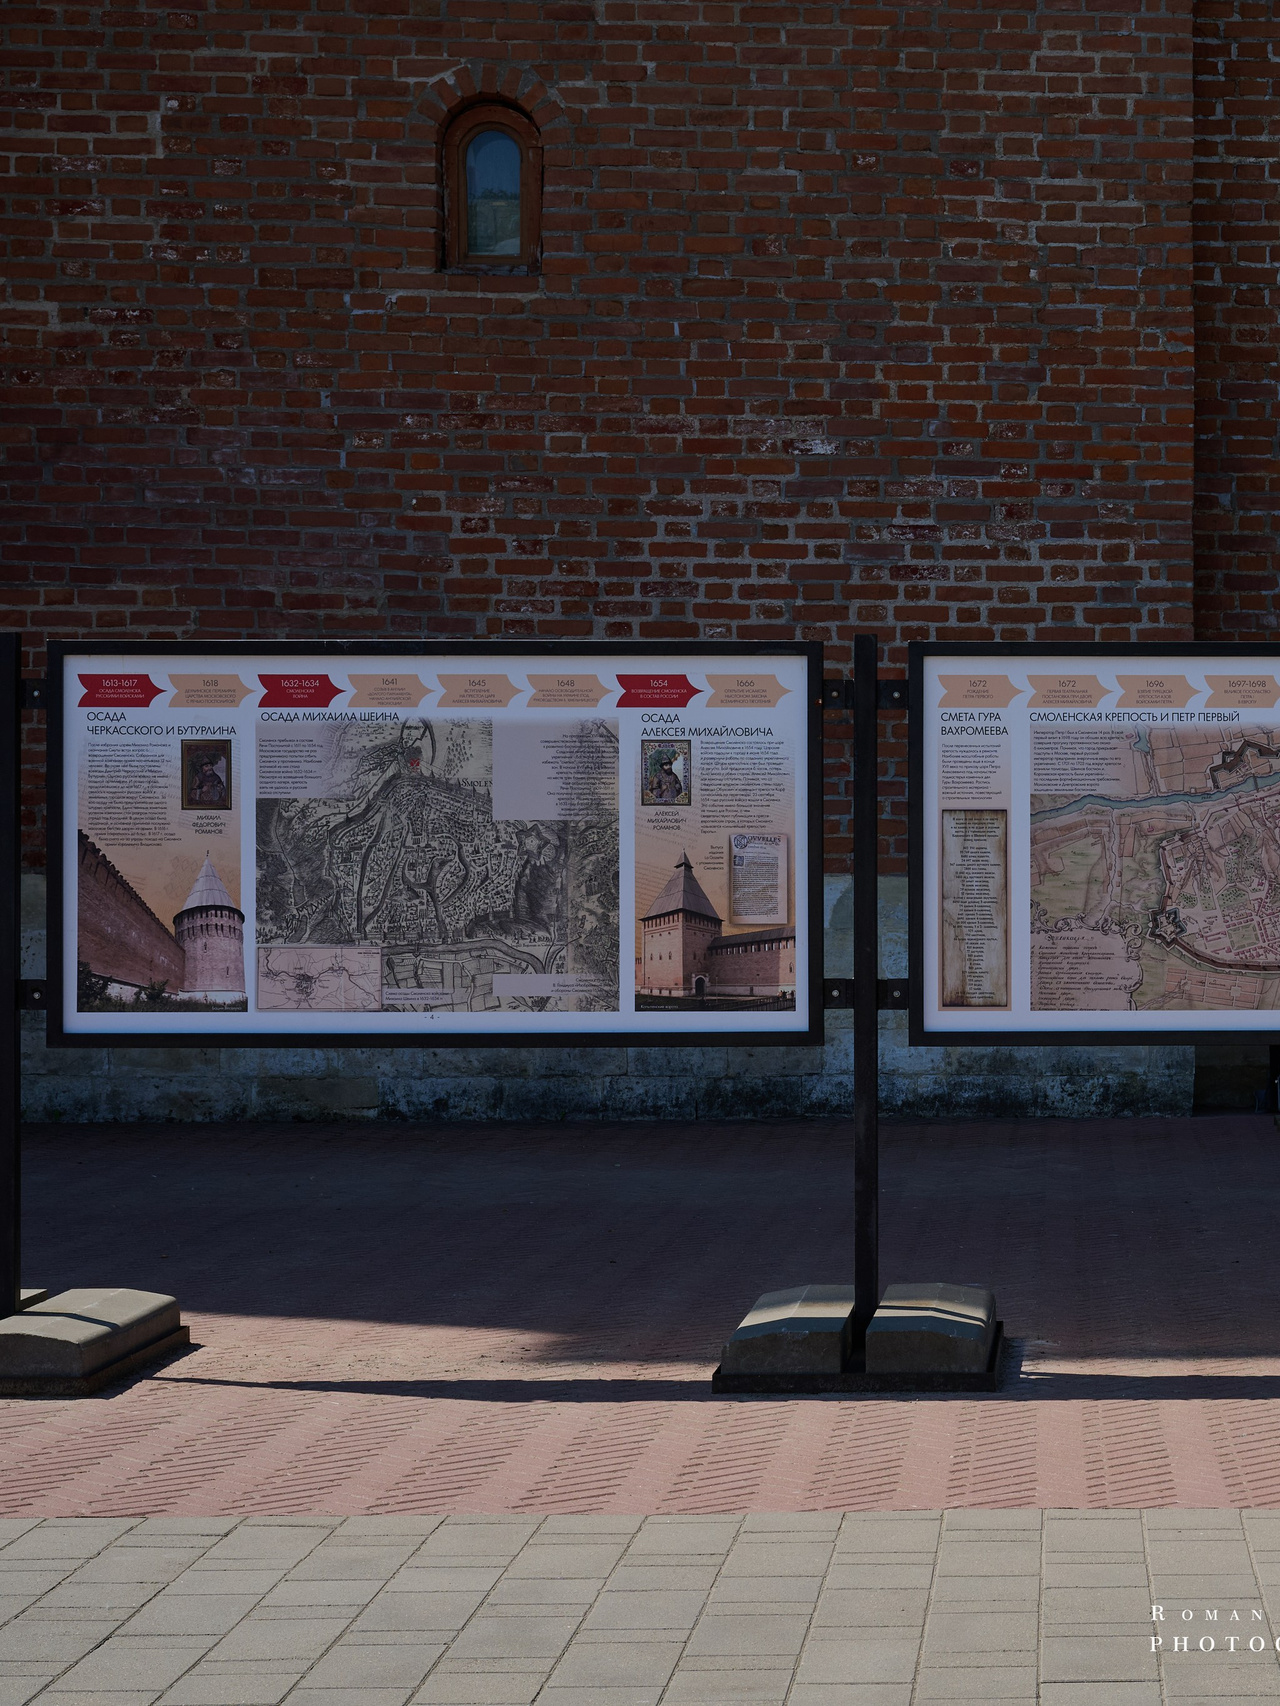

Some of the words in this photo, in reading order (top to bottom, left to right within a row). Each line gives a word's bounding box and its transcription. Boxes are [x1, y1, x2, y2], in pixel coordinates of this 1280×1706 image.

[102, 679, 138, 687] 1613-1617
[202, 679, 219, 687] 1618
[281, 679, 319, 687] 1632-1634
[468, 679, 487, 687] 1645
[557, 679, 576, 687] 1648
[650, 679, 668, 687] 1654
[737, 679, 755, 687] 1666
[969, 679, 988, 687] 1672
[1058, 679, 1077, 687] 1672
[1146, 679, 1164, 687] 1696
[1228, 679, 1266, 687] 1697-1698
[87, 712, 127, 722] ОСАДА
[260, 712, 300, 722] ОСАДА
[302, 712, 358, 722] МИХАИЛА
[359, 712, 400, 722] ШЕИНА
[641, 713, 681, 724] ОСАДА
[940, 712, 975, 722] СМЕТА
[978, 712, 1002, 722] ГУРА
[1029, 713, 1103, 722] СМОЛЕНСКАЯ
[1105, 713, 1158, 722] КРЕПОСТЬ
[1160, 713, 1169, 722] И
[1171, 713, 1196, 722] ПЕТР
[1197, 711, 1240, 722] ПЕРВЫЙ
[87, 725, 163, 735] ЧЕРКАССКОГО
[165, 725, 174, 735] И
[177, 725, 236, 735] БУТУРЛИНА
[641, 727, 686, 737] АЛЕКСЕЯ
[688, 725, 774, 737] МИХАЙЛОВИЧА
[940, 726, 1009, 736] ВАХРОМЕЕВА
